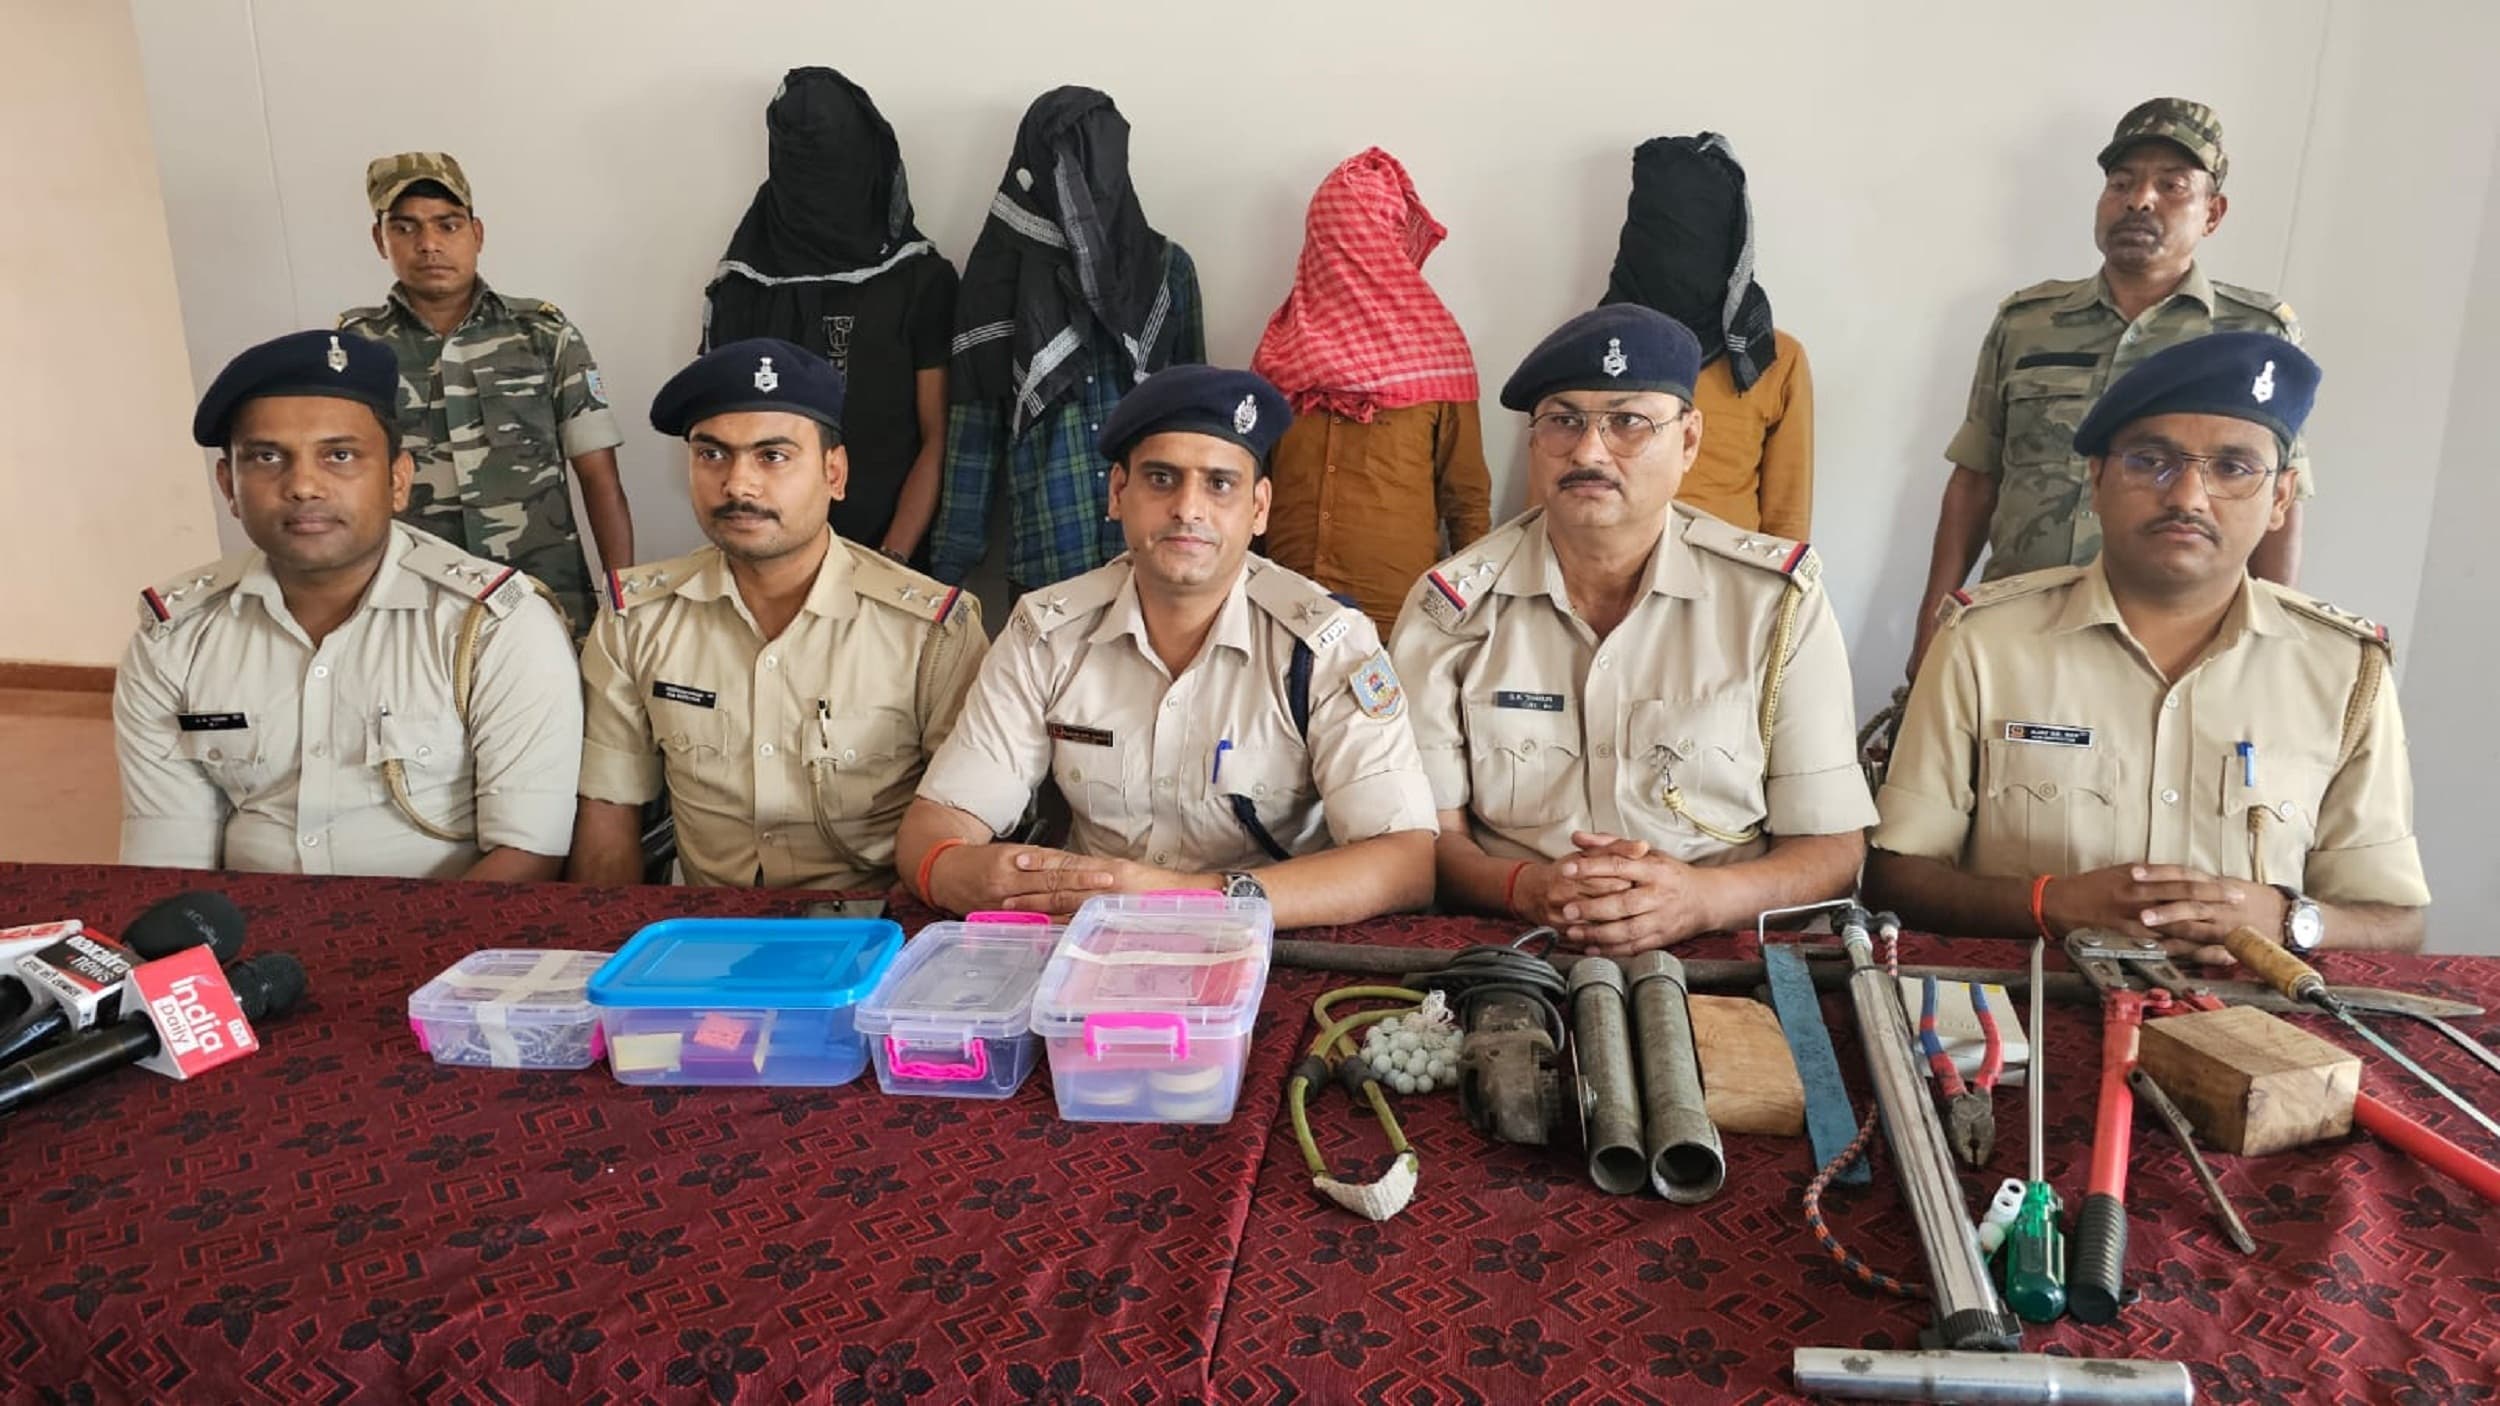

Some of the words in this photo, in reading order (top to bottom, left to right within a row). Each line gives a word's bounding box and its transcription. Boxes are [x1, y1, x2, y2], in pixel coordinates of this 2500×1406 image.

[70, 956, 109, 982] news
[159, 1003, 189, 1043] Daily
[169, 976, 224, 1055] India
